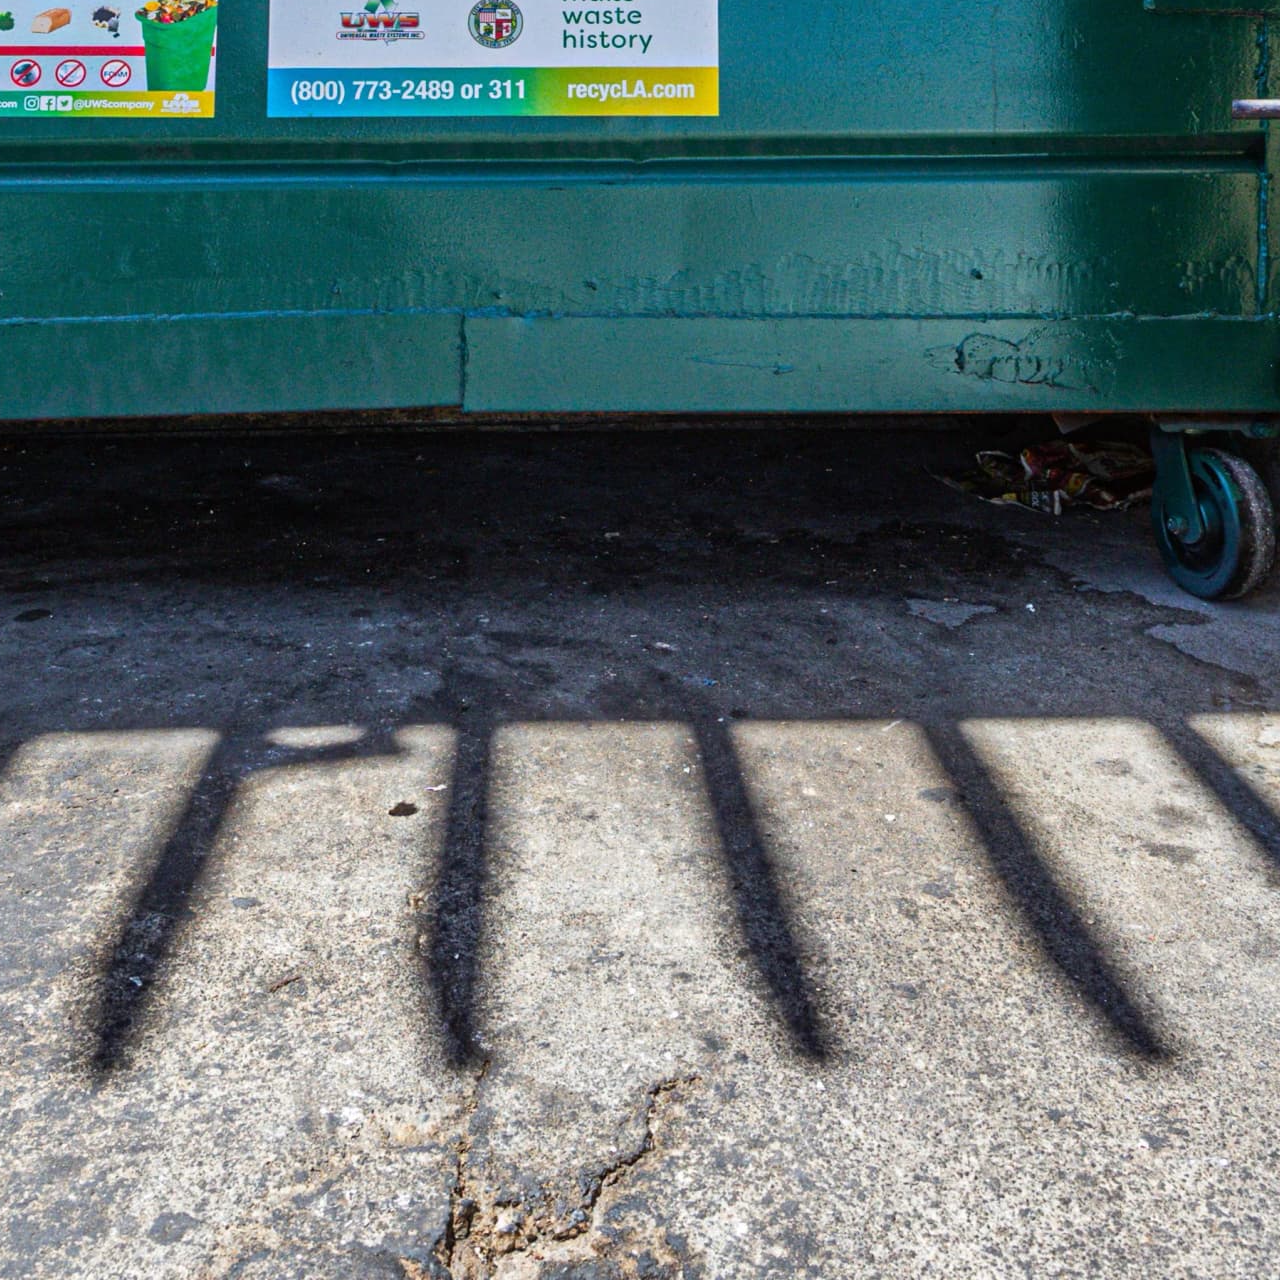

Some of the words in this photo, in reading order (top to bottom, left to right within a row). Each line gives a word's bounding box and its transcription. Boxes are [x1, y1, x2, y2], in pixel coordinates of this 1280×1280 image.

[339, 12, 419, 29] UWS
[562, 7, 643, 26] waste
[563, 29, 653, 54] history
[290, 79, 346, 104] (800)
[352, 80, 455, 100] 773-2489
[461, 84, 483, 100] or
[488, 80, 526, 100] 311
[567, 81, 695, 103] recycLA.com
[73, 99, 155, 111] @UWScompany
